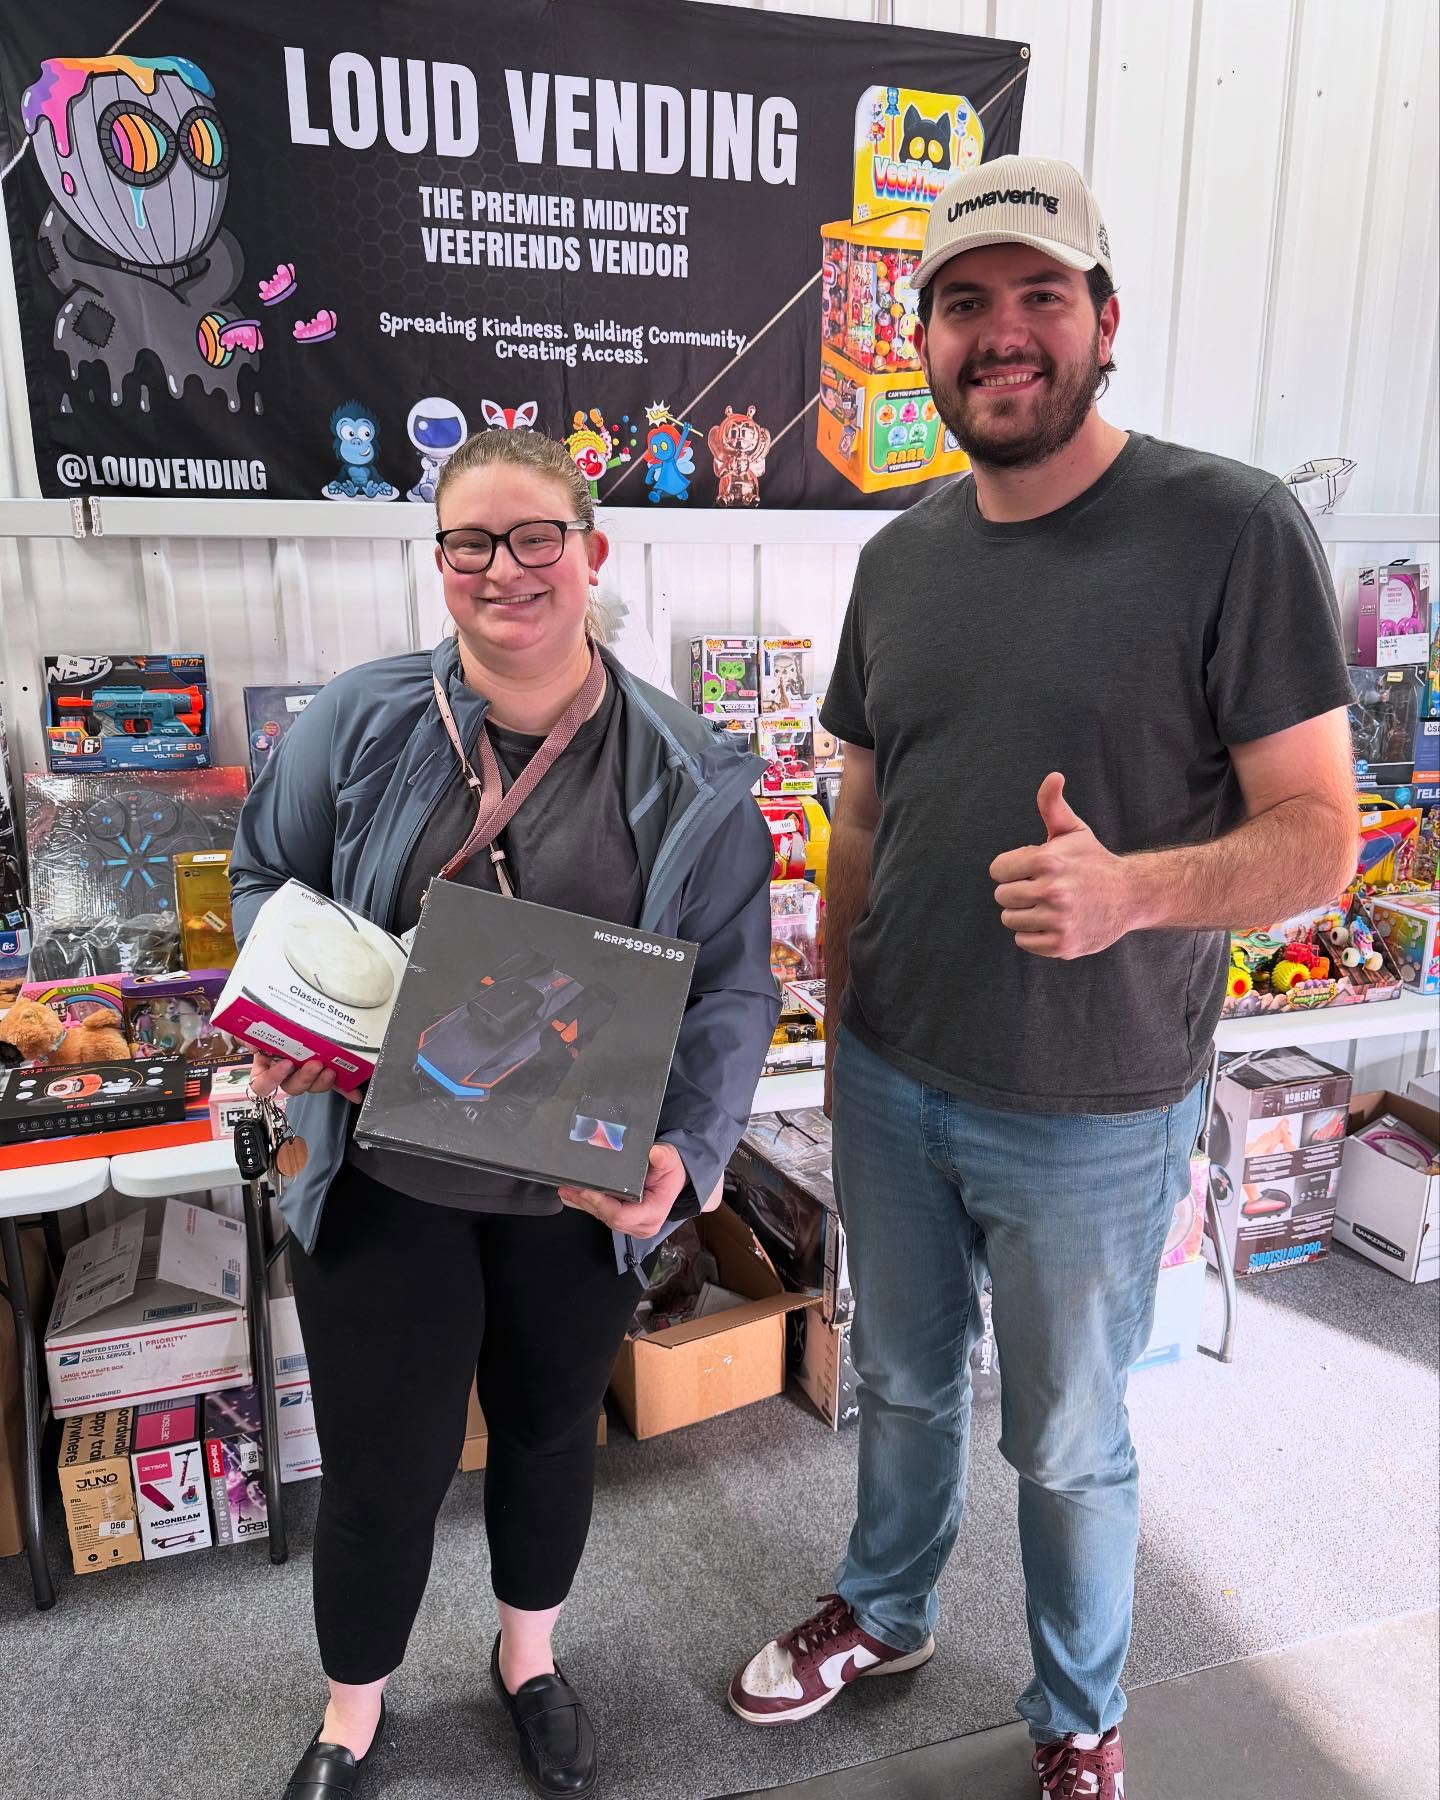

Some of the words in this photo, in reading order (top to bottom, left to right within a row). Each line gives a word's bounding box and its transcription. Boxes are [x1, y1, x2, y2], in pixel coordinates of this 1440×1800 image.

[284, 46, 480, 158] LOUD
[504, 69, 799, 186] VENDING
[418, 186, 464, 220] THE
[471, 190, 576, 228] PREMIER
[583, 198, 689, 236] MIDWEST
[947, 186, 1060, 223] Unwavering
[420, 226, 581, 272] VEEFRIENDS
[588, 237, 689, 279] VENDOR
[379, 311, 477, 342] Spreading
[481, 315, 569, 341] Kindness.
[573, 319, 644, 348] Building
[495, 340, 577, 368] Creating
[582, 344, 649, 366] Access.
[57, 453, 268, 491] @LOUDVENDING
[131, 743, 187, 753] ELITE
[593, 931, 685, 962] MSRP$999.99
[289, 984, 326, 1010] Classic
[326, 1002, 356, 1026] Stone
[1387, 1244, 1403, 1258] BOX
[81, 1355, 105, 1363] POSTAL
[82, 1346, 106, 1355] UNITED
[107, 1342, 130, 1351] STATES
[95, 1389, 121, 1397] INSURED
[75, 1473, 119, 1489] JUNO
[110, 1520, 126, 1530] 066
[150, 1512, 201, 1528] MOONBEAM
